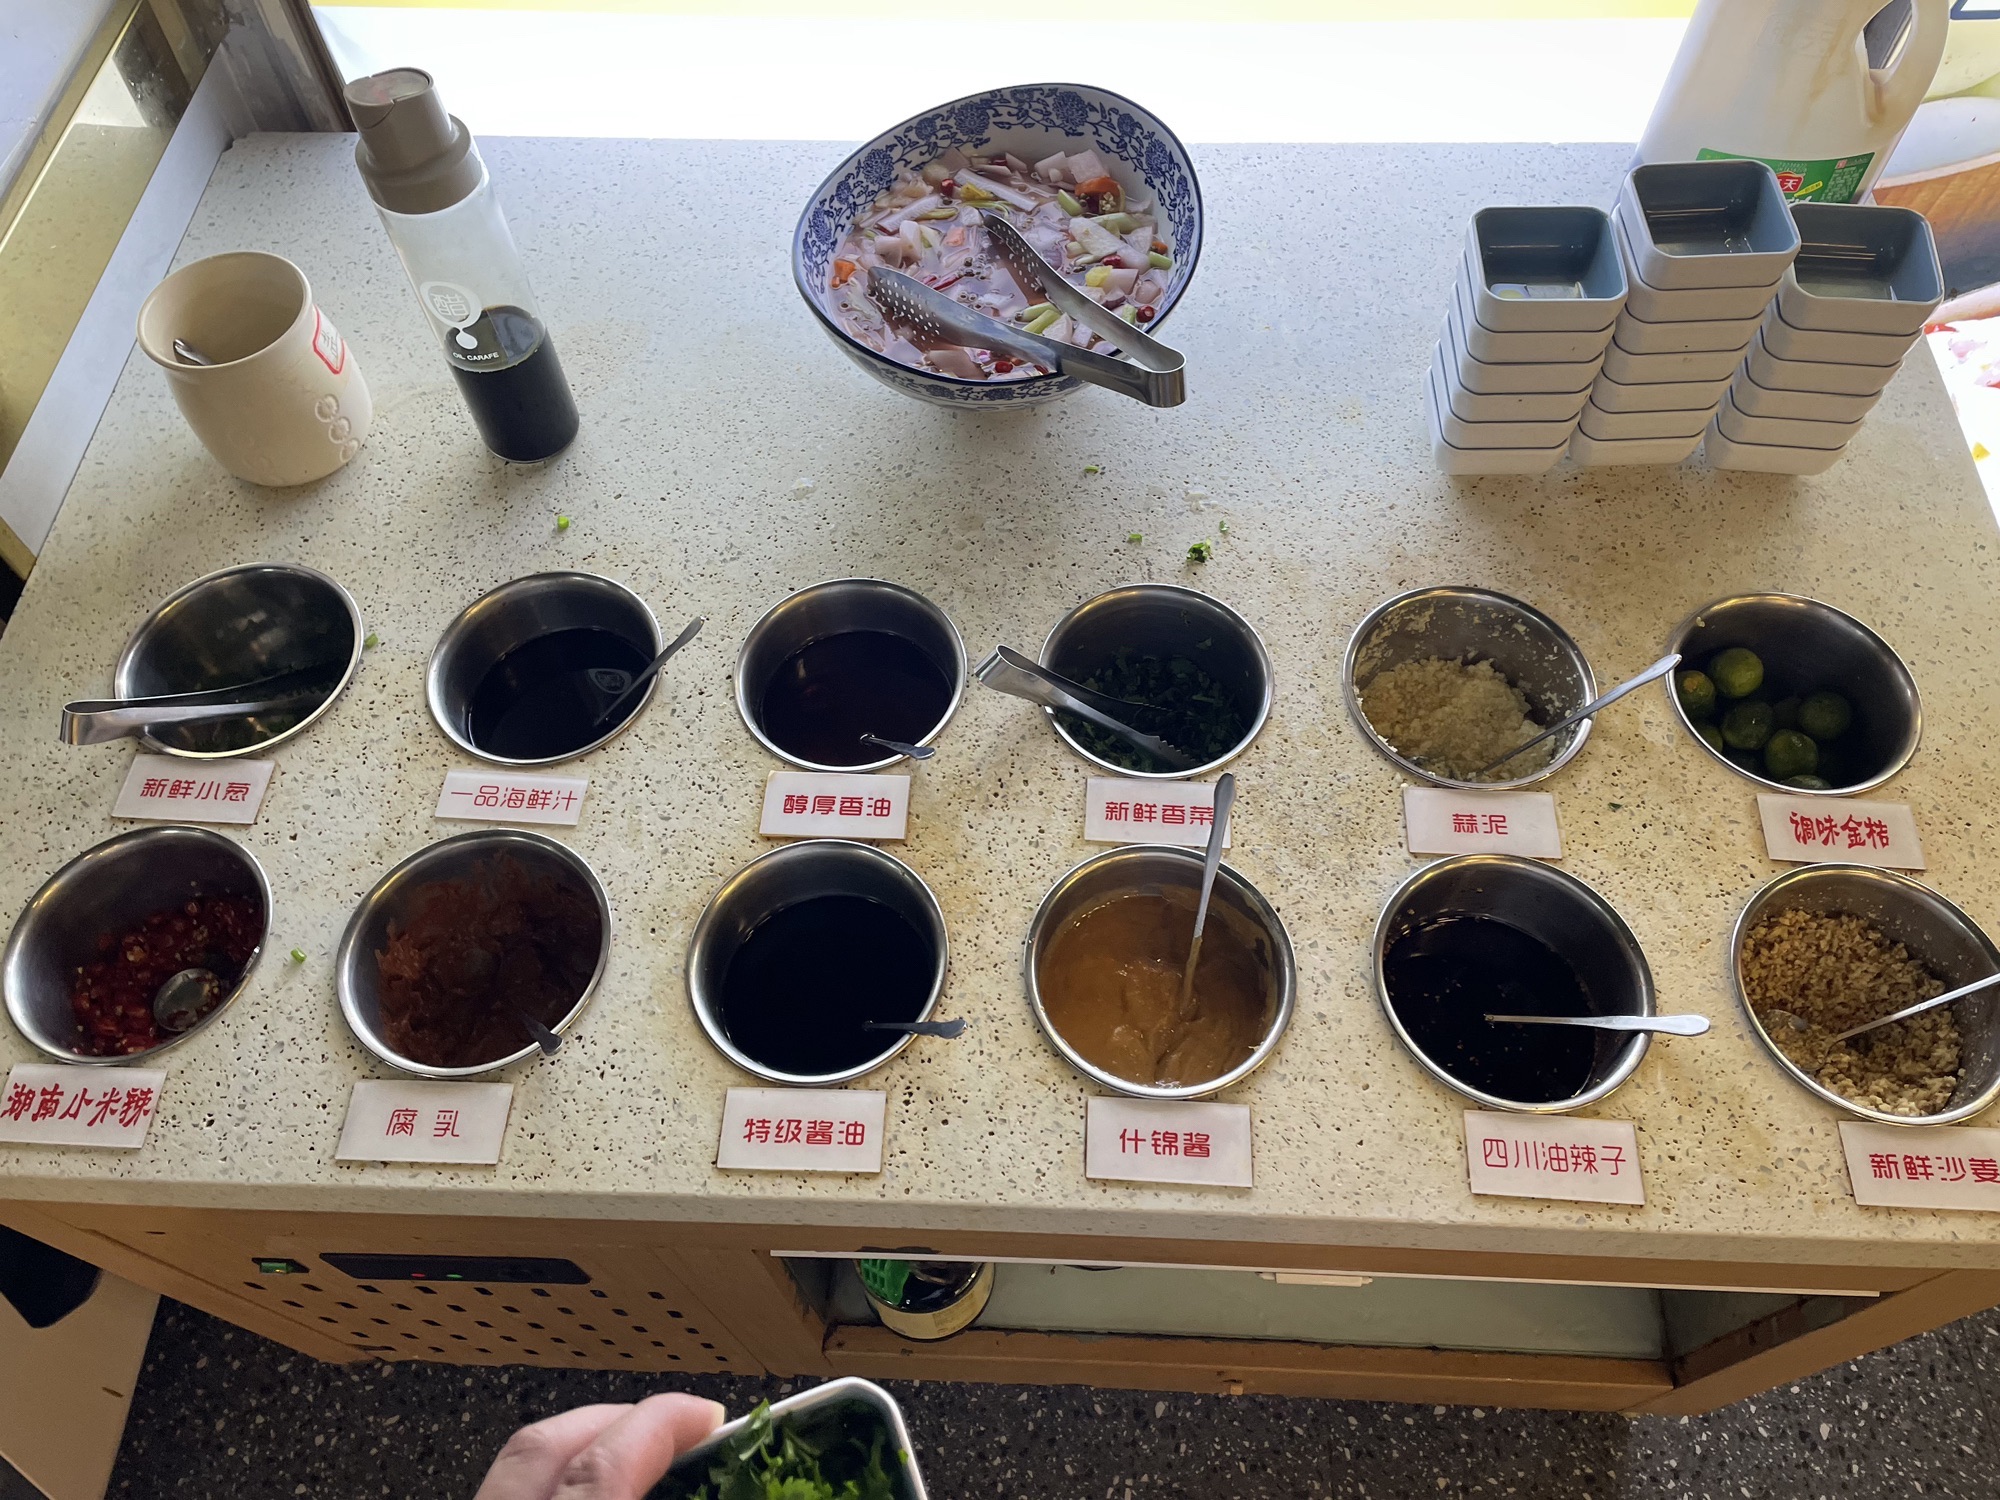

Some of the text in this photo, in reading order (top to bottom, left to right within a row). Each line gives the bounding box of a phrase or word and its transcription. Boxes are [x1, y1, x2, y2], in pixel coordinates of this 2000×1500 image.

[466, 351, 500, 361] CARAFE
[140, 778, 251, 801] 新鲜小葱
[451, 785, 578, 811] 一品海鲜汁
[783, 794, 892, 818] 醇厚香油
[1105, 801, 1214, 826] 新鲜香菜
[1452, 812, 1508, 836] 蒜泥
[1788, 810, 1891, 850] 调味金桔
[1, 1083, 154, 1129] 湖南小米辣
[385, 1108, 459, 1138] 腐乳
[743, 1118, 866, 1147] 特级酱油
[1119, 1128, 1211, 1159] 什锦酱
[1482, 1137, 1627, 1177] 四川油辣子
[1868, 1152, 2000, 1185] 新鲜沙姜
